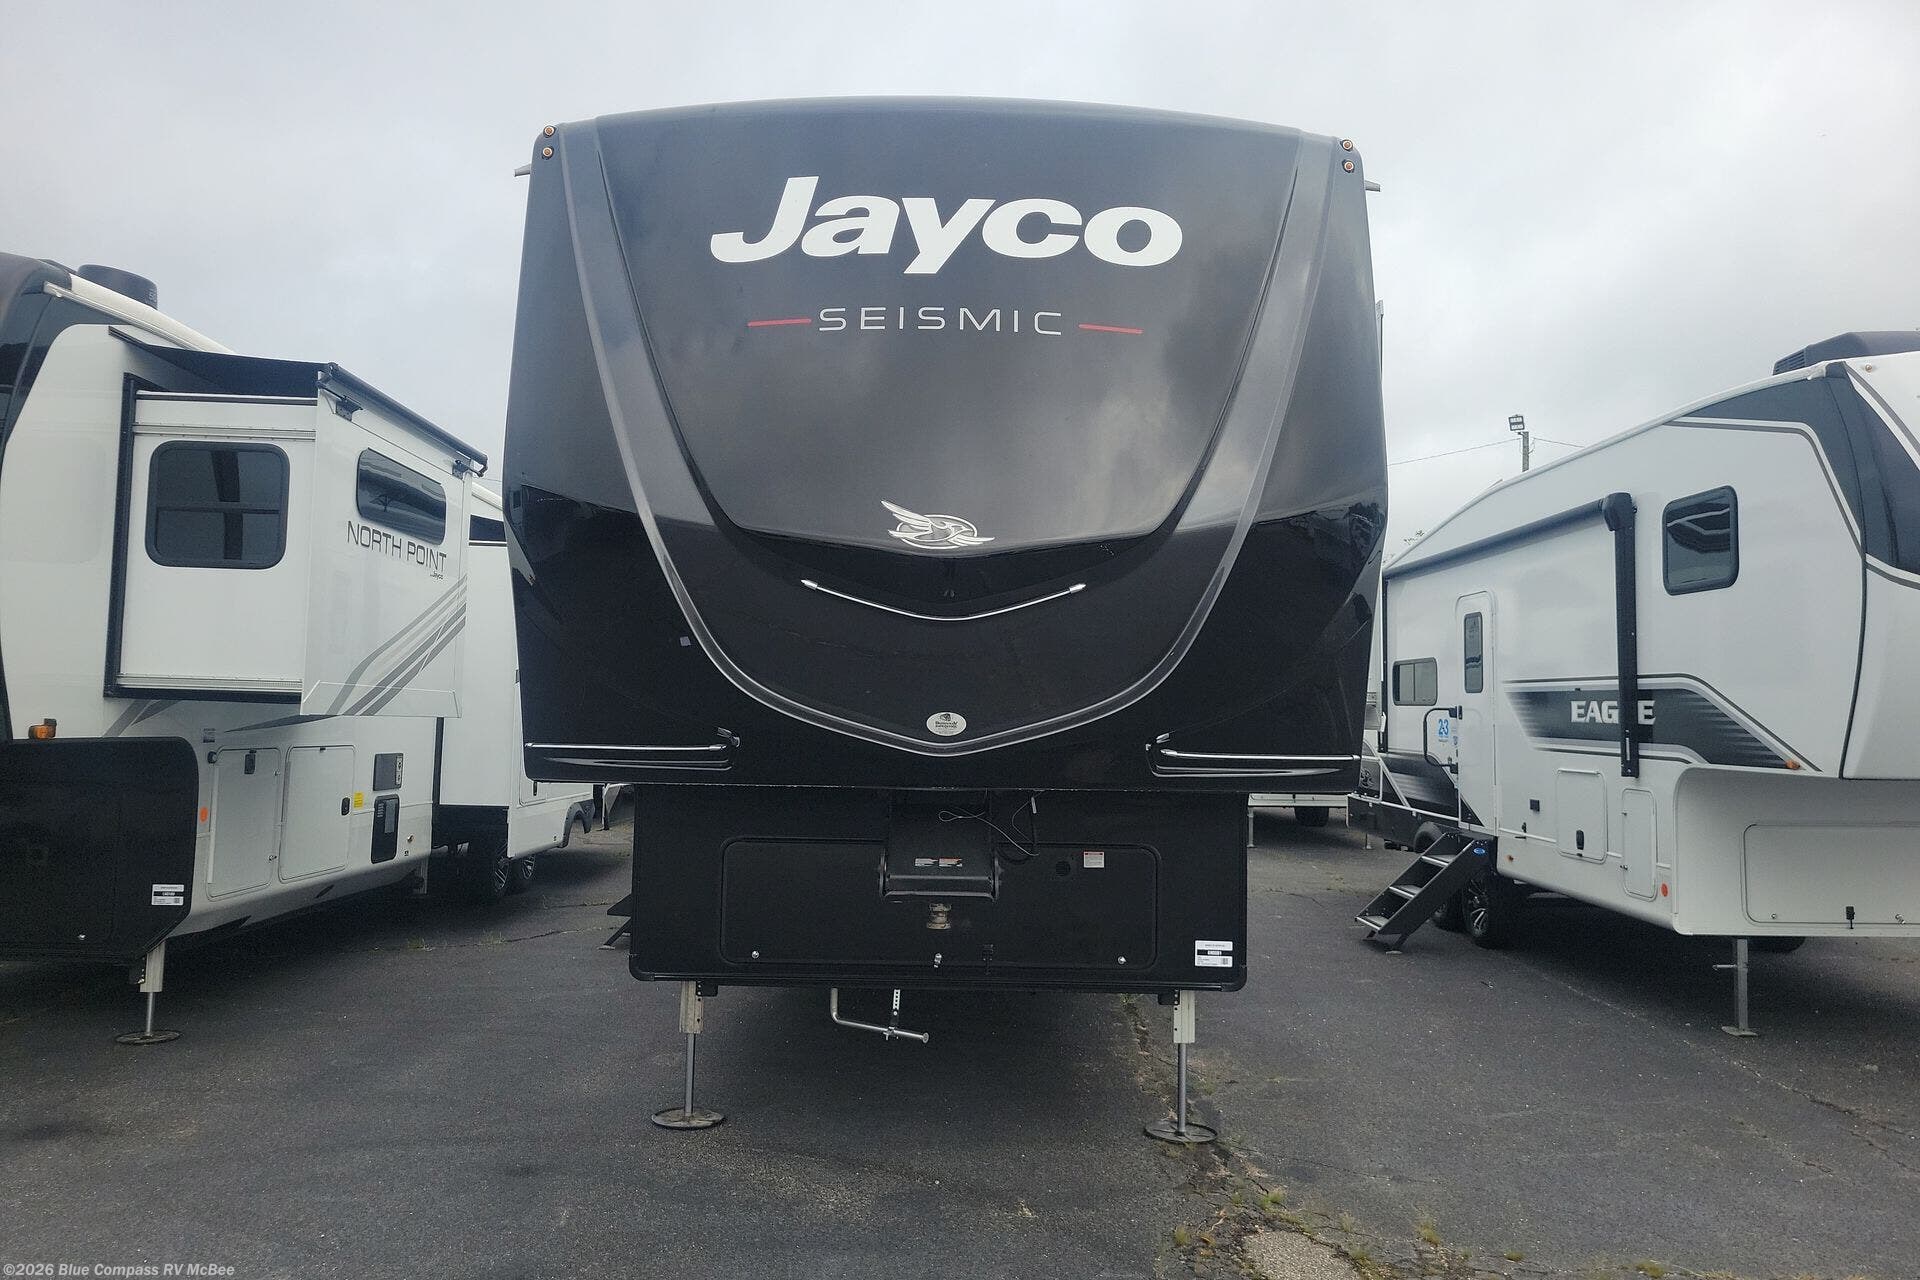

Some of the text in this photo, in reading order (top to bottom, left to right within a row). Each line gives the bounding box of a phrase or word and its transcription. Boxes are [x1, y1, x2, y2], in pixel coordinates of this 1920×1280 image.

[710, 176, 1183, 274] Jayco
[818, 306, 1062, 336] SEISMIC
[347, 520, 447, 572] NORTH POINT
[1571, 700, 1656, 725] EAGE
